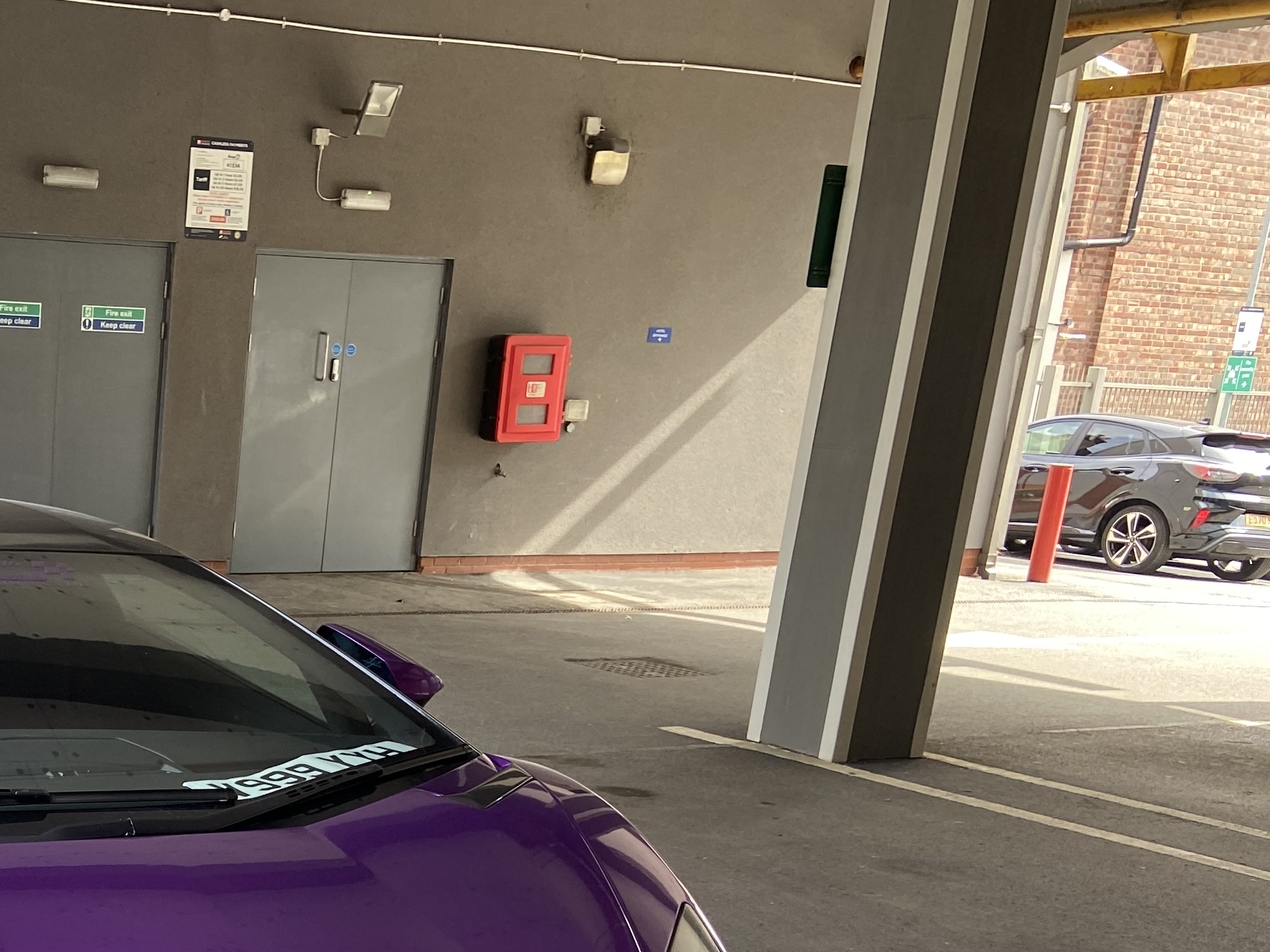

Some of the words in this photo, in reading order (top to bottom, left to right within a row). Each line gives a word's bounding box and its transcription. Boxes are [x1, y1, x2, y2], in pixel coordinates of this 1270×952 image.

[0, 304, 13, 312] Fire
[105, 309, 119, 317] Fire
[14, 317, 32, 325] clear
[100, 321, 118, 330] Keep
